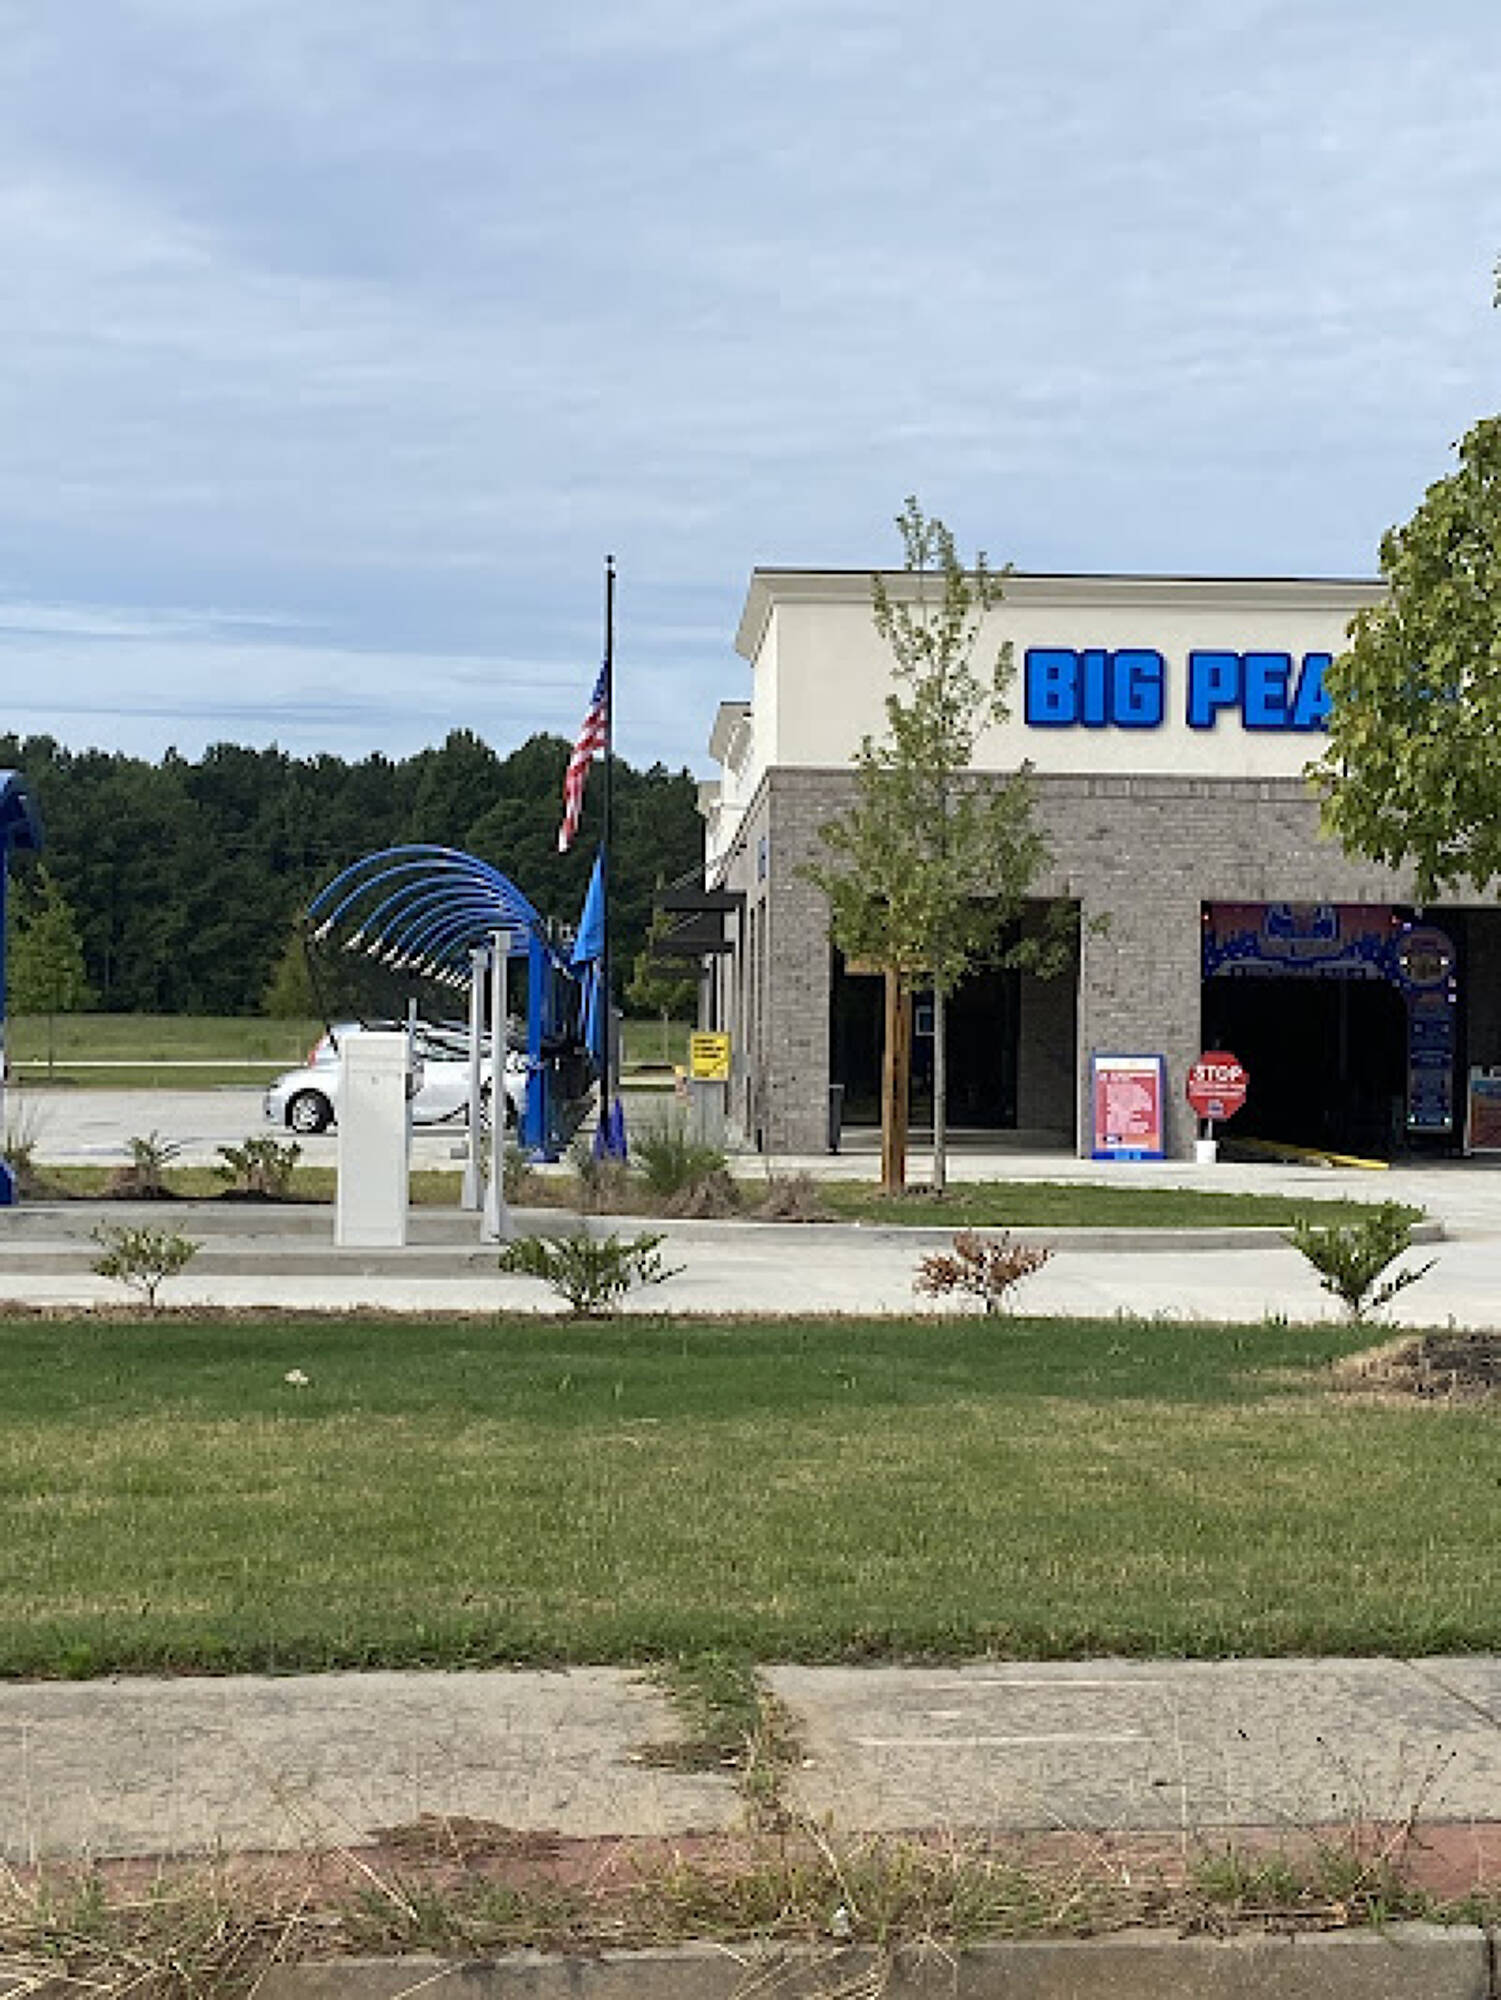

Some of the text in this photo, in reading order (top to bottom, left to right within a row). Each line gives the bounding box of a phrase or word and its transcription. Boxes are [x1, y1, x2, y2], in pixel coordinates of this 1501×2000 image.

[1025, 648, 1333, 731] BIG PEA
[1193, 1064, 1243, 1081] STOP
